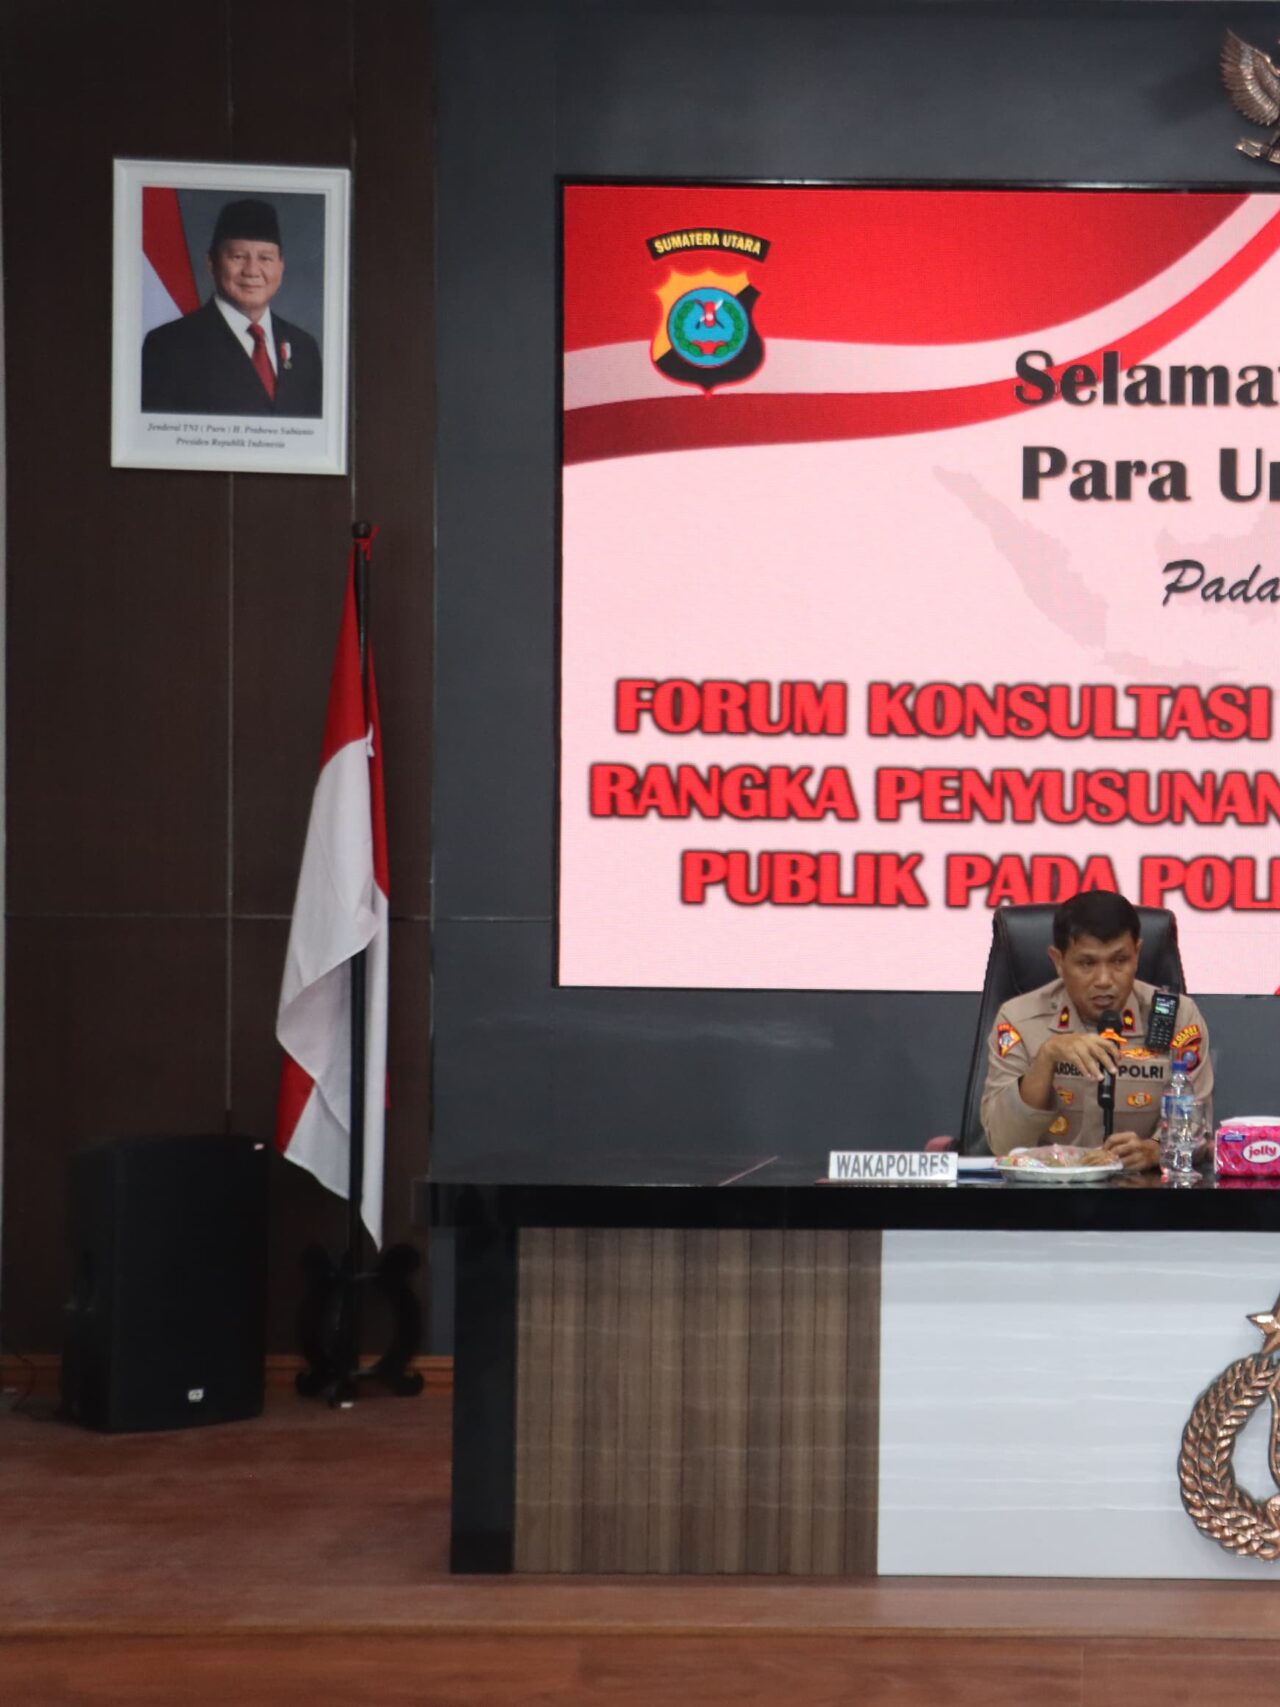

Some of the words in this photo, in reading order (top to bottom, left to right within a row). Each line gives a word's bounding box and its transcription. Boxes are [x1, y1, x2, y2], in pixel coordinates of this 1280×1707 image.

[653, 232, 720, 254] SUMATERA
[722, 234, 762, 255] UTARA
[1021, 445, 1192, 502] Para
[614, 679, 848, 735] FORUM
[866, 681, 1273, 741] KONSULTASI
[589, 763, 860, 821] RANGKA
[681, 849, 929, 907] PUBLIK
[945, 852, 1120, 908] PADA
[1118, 1065, 1164, 1079] POLRI
[836, 1153, 950, 1178] WAKAPOLRES
[1248, 1144, 1278, 1159] jolly
